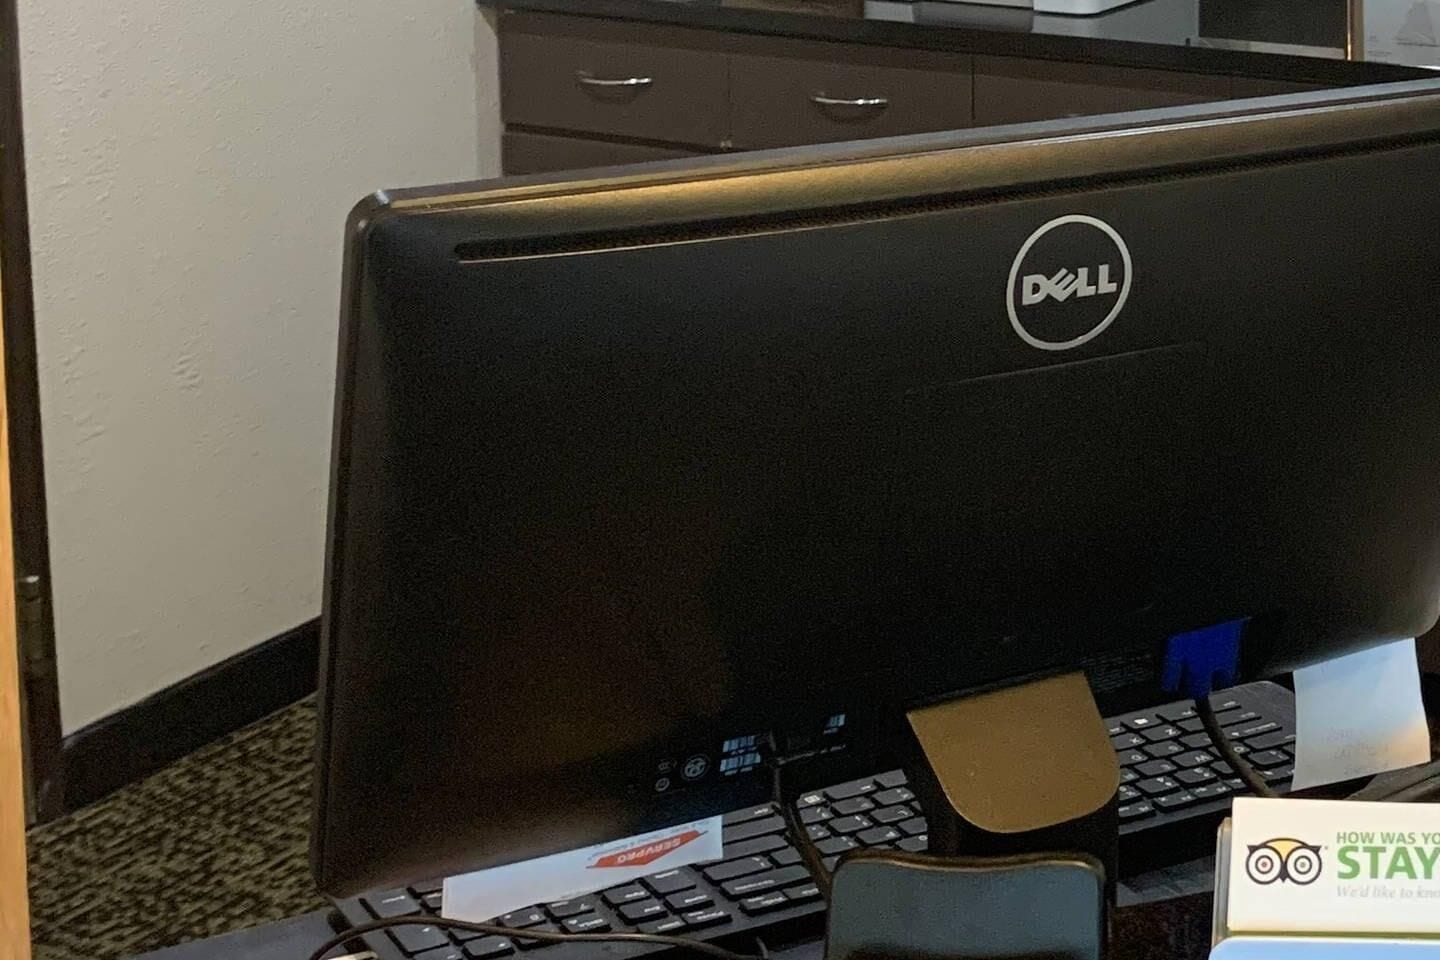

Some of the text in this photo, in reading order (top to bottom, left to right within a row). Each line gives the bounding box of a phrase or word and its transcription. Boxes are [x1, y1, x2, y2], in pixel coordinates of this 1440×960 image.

[1022, 264, 1118, 306] DELL
[1336, 831, 1375, 845] HOW
[1380, 831, 1416, 845] WAS
[615, 836, 681, 865] SERVPRO
[1337, 885, 1369, 898] We'd
[1372, 886, 1396, 898] like
[1400, 888, 1413, 898] to
